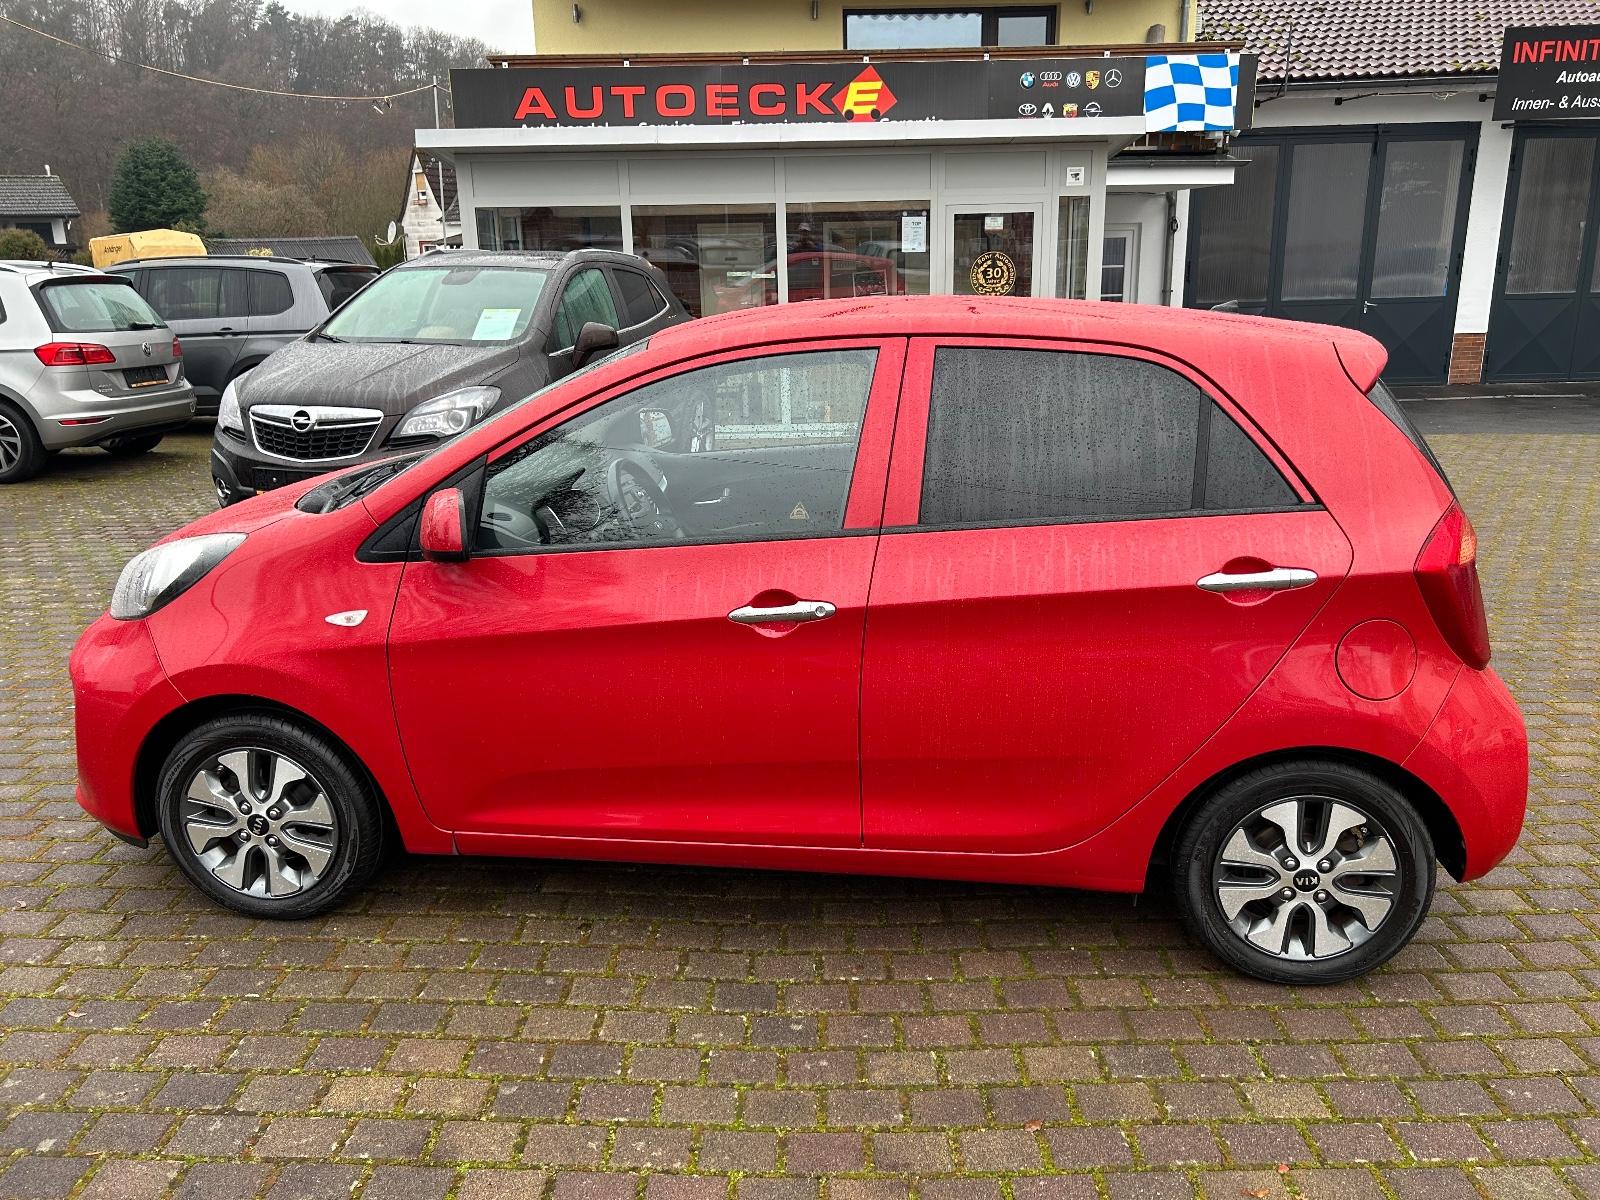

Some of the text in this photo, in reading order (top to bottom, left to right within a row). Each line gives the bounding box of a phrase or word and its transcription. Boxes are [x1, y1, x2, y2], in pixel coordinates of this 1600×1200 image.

[1513, 39, 1600, 64] INFINIT
[1511, 97, 1555, 111] Innen-
[1558, 95, 1569, 109] &
[985, 267, 1002, 279] 30
[1295, 876, 1318, 886] KIA
